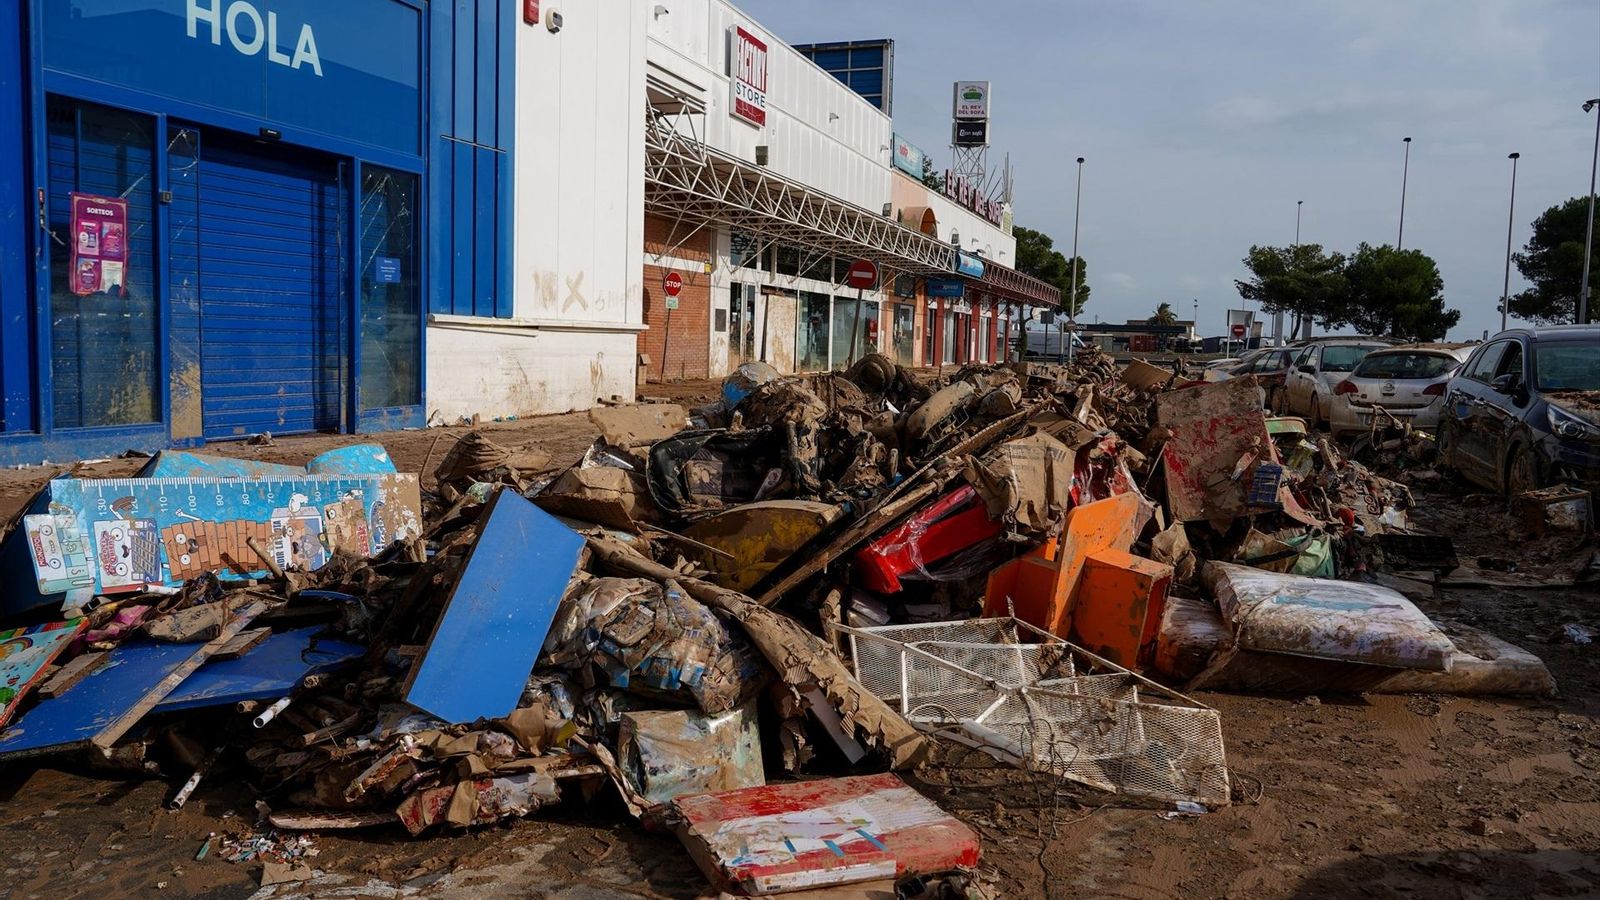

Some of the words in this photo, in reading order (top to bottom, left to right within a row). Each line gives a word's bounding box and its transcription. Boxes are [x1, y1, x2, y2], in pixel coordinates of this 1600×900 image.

[186, 0, 323, 77] HOLA
[736, 82, 766, 108] STORE
[945, 169, 957, 200] EL
[86, 207, 114, 216] SORTEOS
[666, 280, 681, 288] STOP
[160, 496, 168, 513] 110
[188, 495, 197, 512] 100
[216, 494, 224, 506] 90
[242, 493, 250, 505] 80
[267, 492, 275, 504] 70
[97, 498, 107, 516] 130
